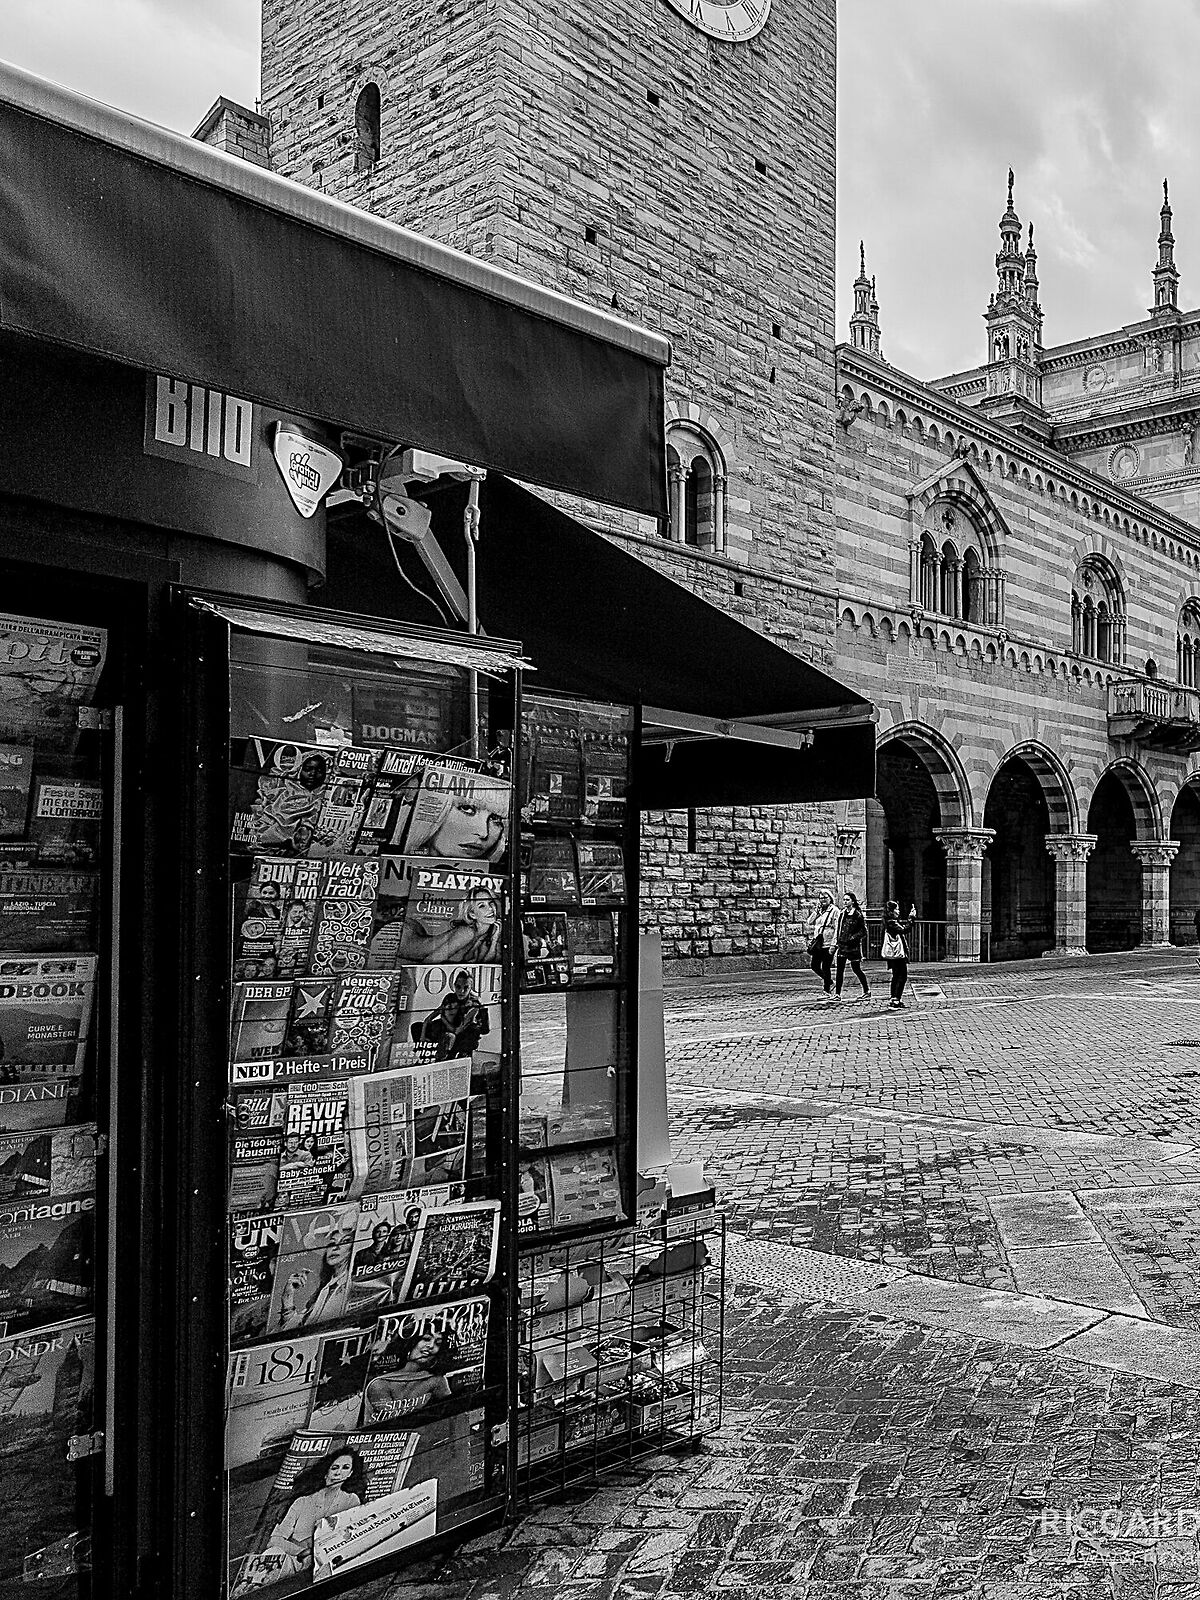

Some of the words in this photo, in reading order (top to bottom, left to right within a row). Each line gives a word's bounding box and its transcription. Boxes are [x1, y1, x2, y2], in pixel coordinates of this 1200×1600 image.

[362, 724, 437, 745] DOGMAN
[338, 759, 350, 769] DE
[350, 760, 369, 771] VUE
[340, 751, 371, 763] POINT
[380, 752, 417, 776] MATCH
[416, 755, 434, 767] Kate
[434, 759, 445, 768] et
[445, 760, 476, 774] William
[44, 787, 75, 798] Feste
[258, 864, 296, 883] BUN
[328, 861, 362, 877] Welt
[324, 877, 359, 897] Frau
[417, 871, 504, 894] PLAYBOY
[416, 900, 455, 918] Glang
[341, 976, 380, 987] Neues
[245, 987, 273, 998] DER
[338, 989, 377, 1008] Frau
[27, 1030, 76, 1040] MONASTERI
[28, 1024, 56, 1034] CURVE
[236, 1064, 271, 1079] NEU
[275, 1062, 284, 1076] 2
[286, 1060, 320, 1075] Hefte
[330, 1058, 336, 1071] 1
[338, 1055, 367, 1070] Preis
[302, 1083, 318, 1092] 100
[288, 1100, 347, 1122] REVUE
[286, 1119, 343, 1137] HEUTE
[235, 1140, 249, 1149] Die
[252, 1139, 266, 1148] 160
[280, 1165, 336, 1179] Baby-Schock!
[346, 1434, 373, 1445] ISABEL
[374, 1432, 408, 1442] PANTOJA
[323, 1523, 375, 1554] International
[374, 1516, 391, 1529] New
[390, 1505, 410, 1520] York
[408, 1495, 431, 1510] Times
